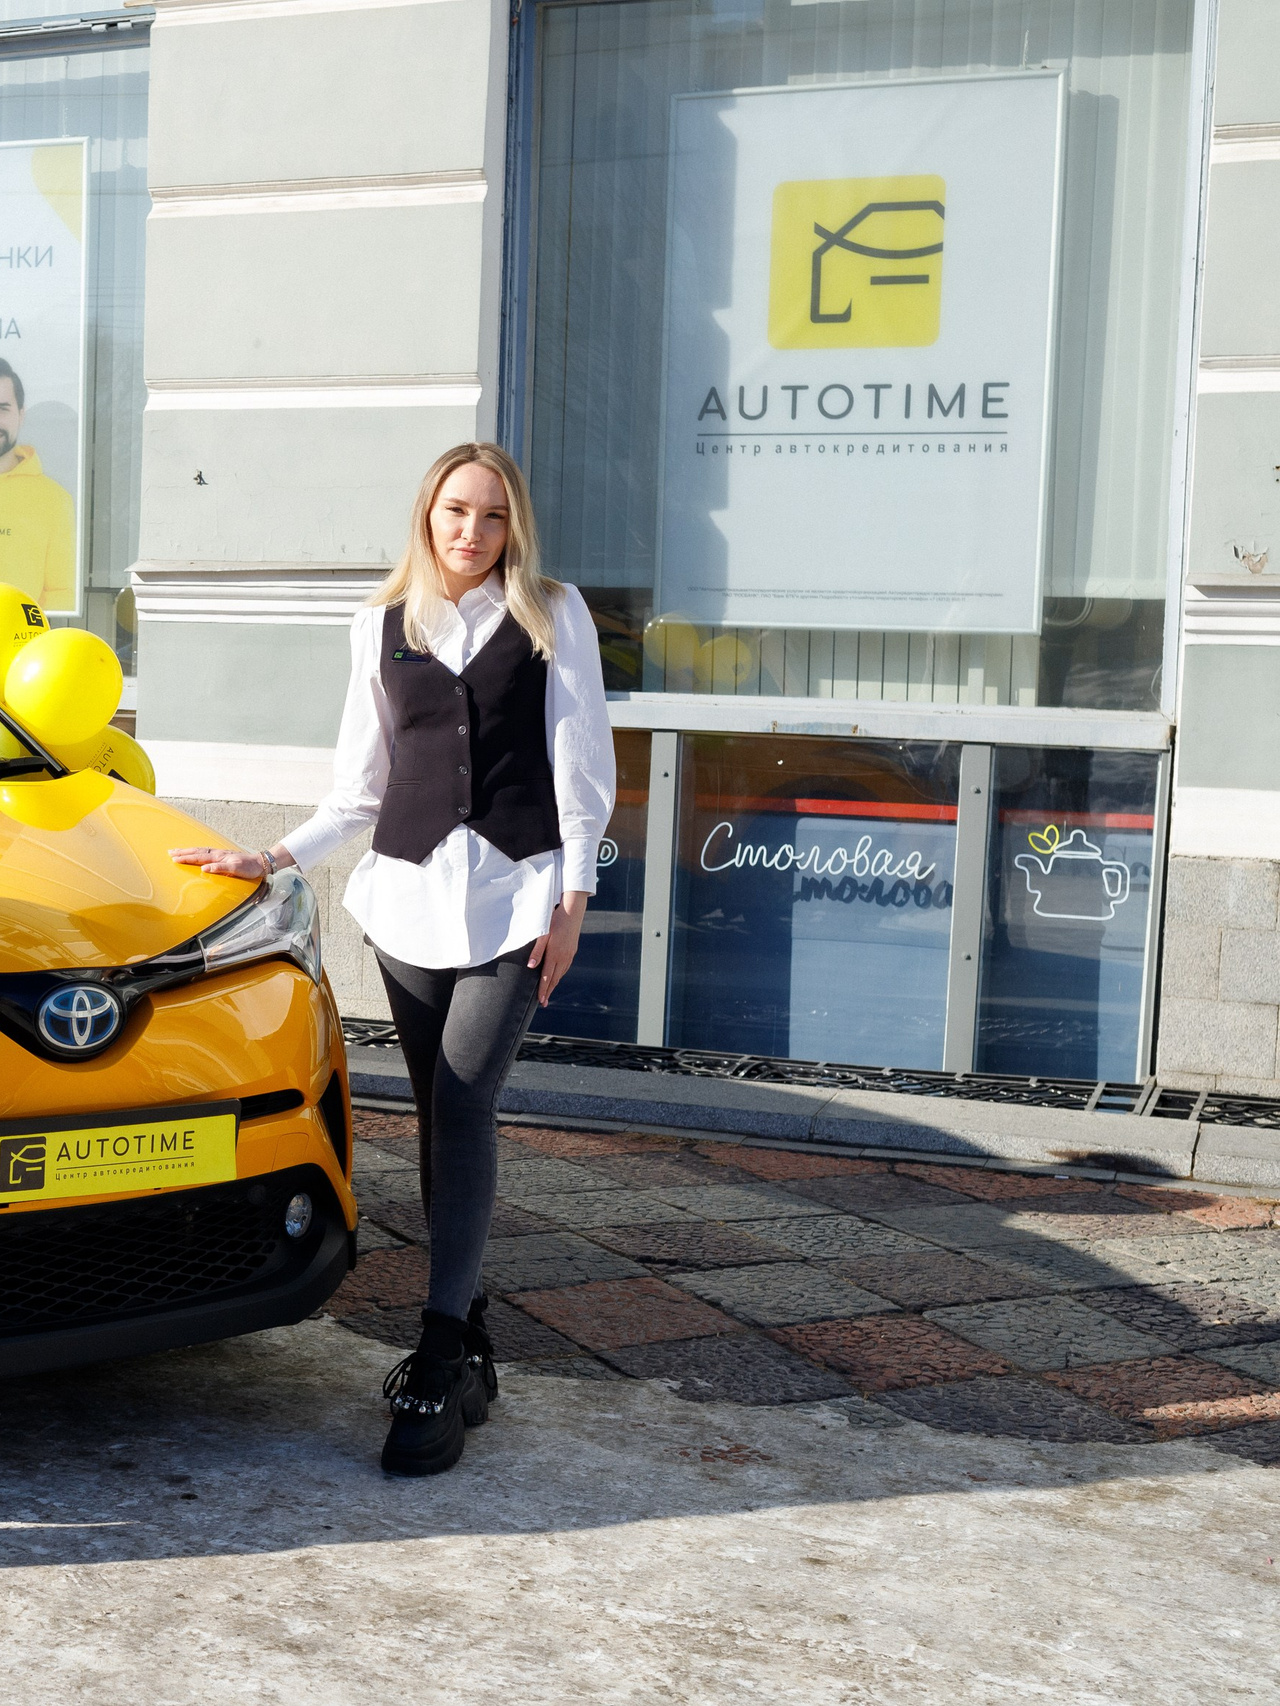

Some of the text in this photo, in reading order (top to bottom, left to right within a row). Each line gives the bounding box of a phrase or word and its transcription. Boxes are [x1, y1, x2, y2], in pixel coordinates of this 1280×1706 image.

[697, 382, 1010, 421] AUTOTIME
[696, 441, 1009, 456] Центр автокредитования
[13, 631, 42, 641] AUTO
[700, 821, 937, 880] Столовая
[56, 1130, 195, 1162] AUTOTIME
[55, 1161, 195, 1181] Центр автокредитования
